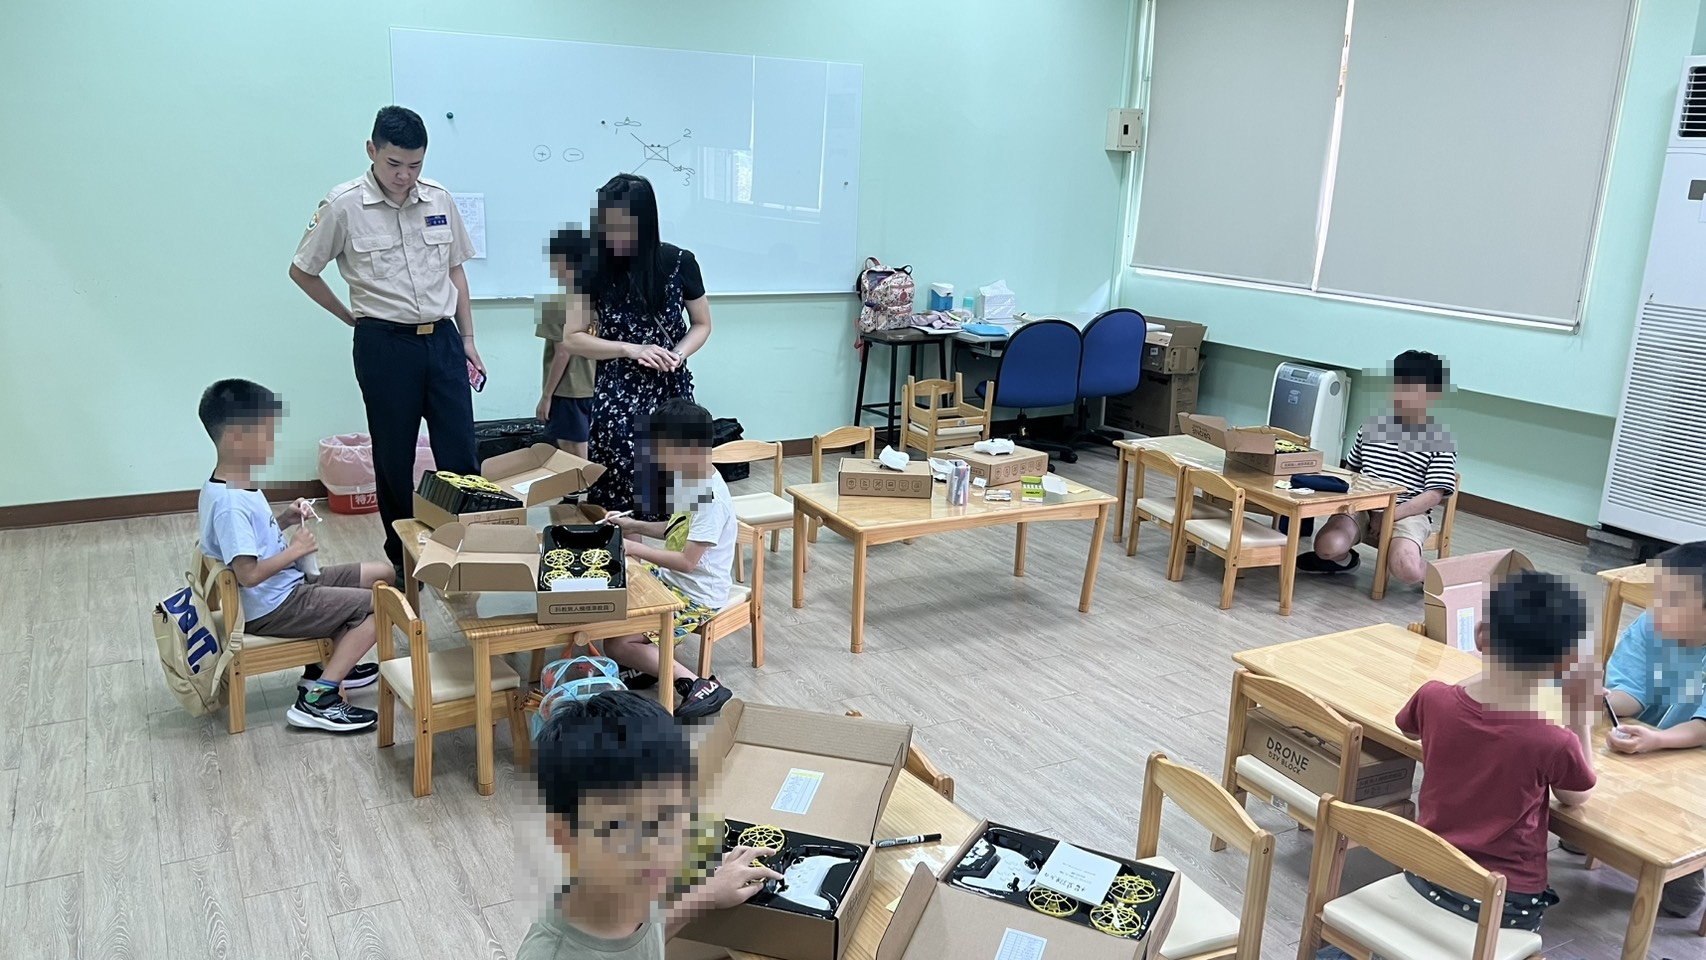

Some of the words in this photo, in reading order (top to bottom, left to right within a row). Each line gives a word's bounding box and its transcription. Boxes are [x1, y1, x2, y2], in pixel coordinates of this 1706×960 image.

[682, 128, 692, 138] 2
[682, 172, 691, 187] 3
[619, 668, 643, 682] FIL
[694, 680, 719, 700] FILA
[1266, 736, 1309, 771] DRONE
[1268, 751, 1280, 762] DIY
[1281, 758, 1301, 775] BLOCK
